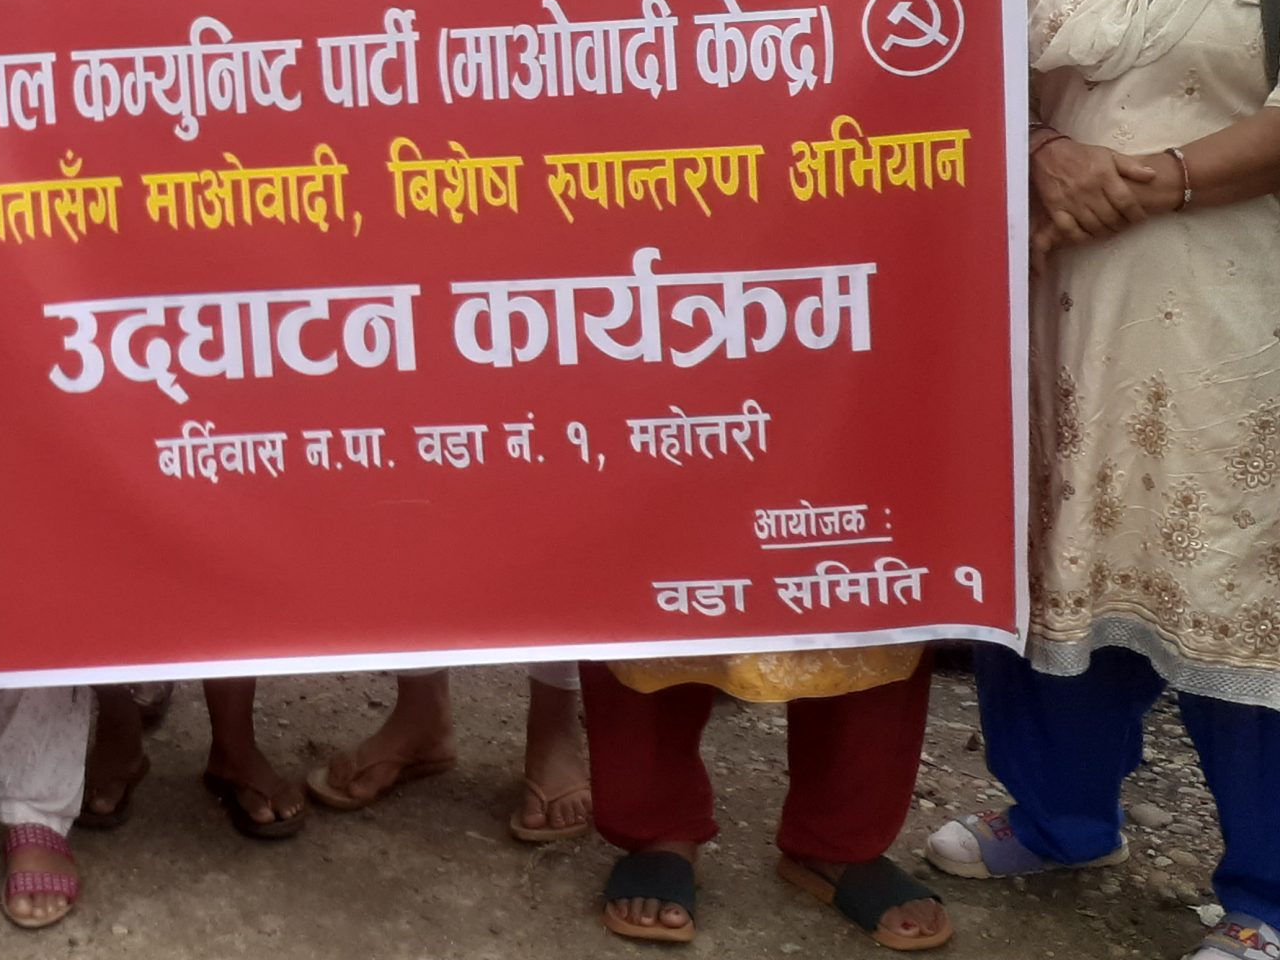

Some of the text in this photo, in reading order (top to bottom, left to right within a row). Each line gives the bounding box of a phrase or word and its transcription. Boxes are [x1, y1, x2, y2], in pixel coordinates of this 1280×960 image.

[71, 16, 303, 142] कम्युनिष्ट
[317, 8, 420, 108] पार्टी
[142, 143, 363, 238] माओवादी,
[387, 136, 524, 224] बिशेष
[543, 142, 765, 224] रुपान्तरण
[789, 114, 971, 202] अभियान
[451, 246, 877, 369] कार्यक्रम
[302, 428, 395, 470] न.पा.
[413, 424, 489, 469] वडा
[503, 411, 545, 464] नं.
[625, 399, 772, 467] महोत्तरी
[753, 499, 869, 540] आयोजक
[651, 556, 984, 617] वडा समिति १
